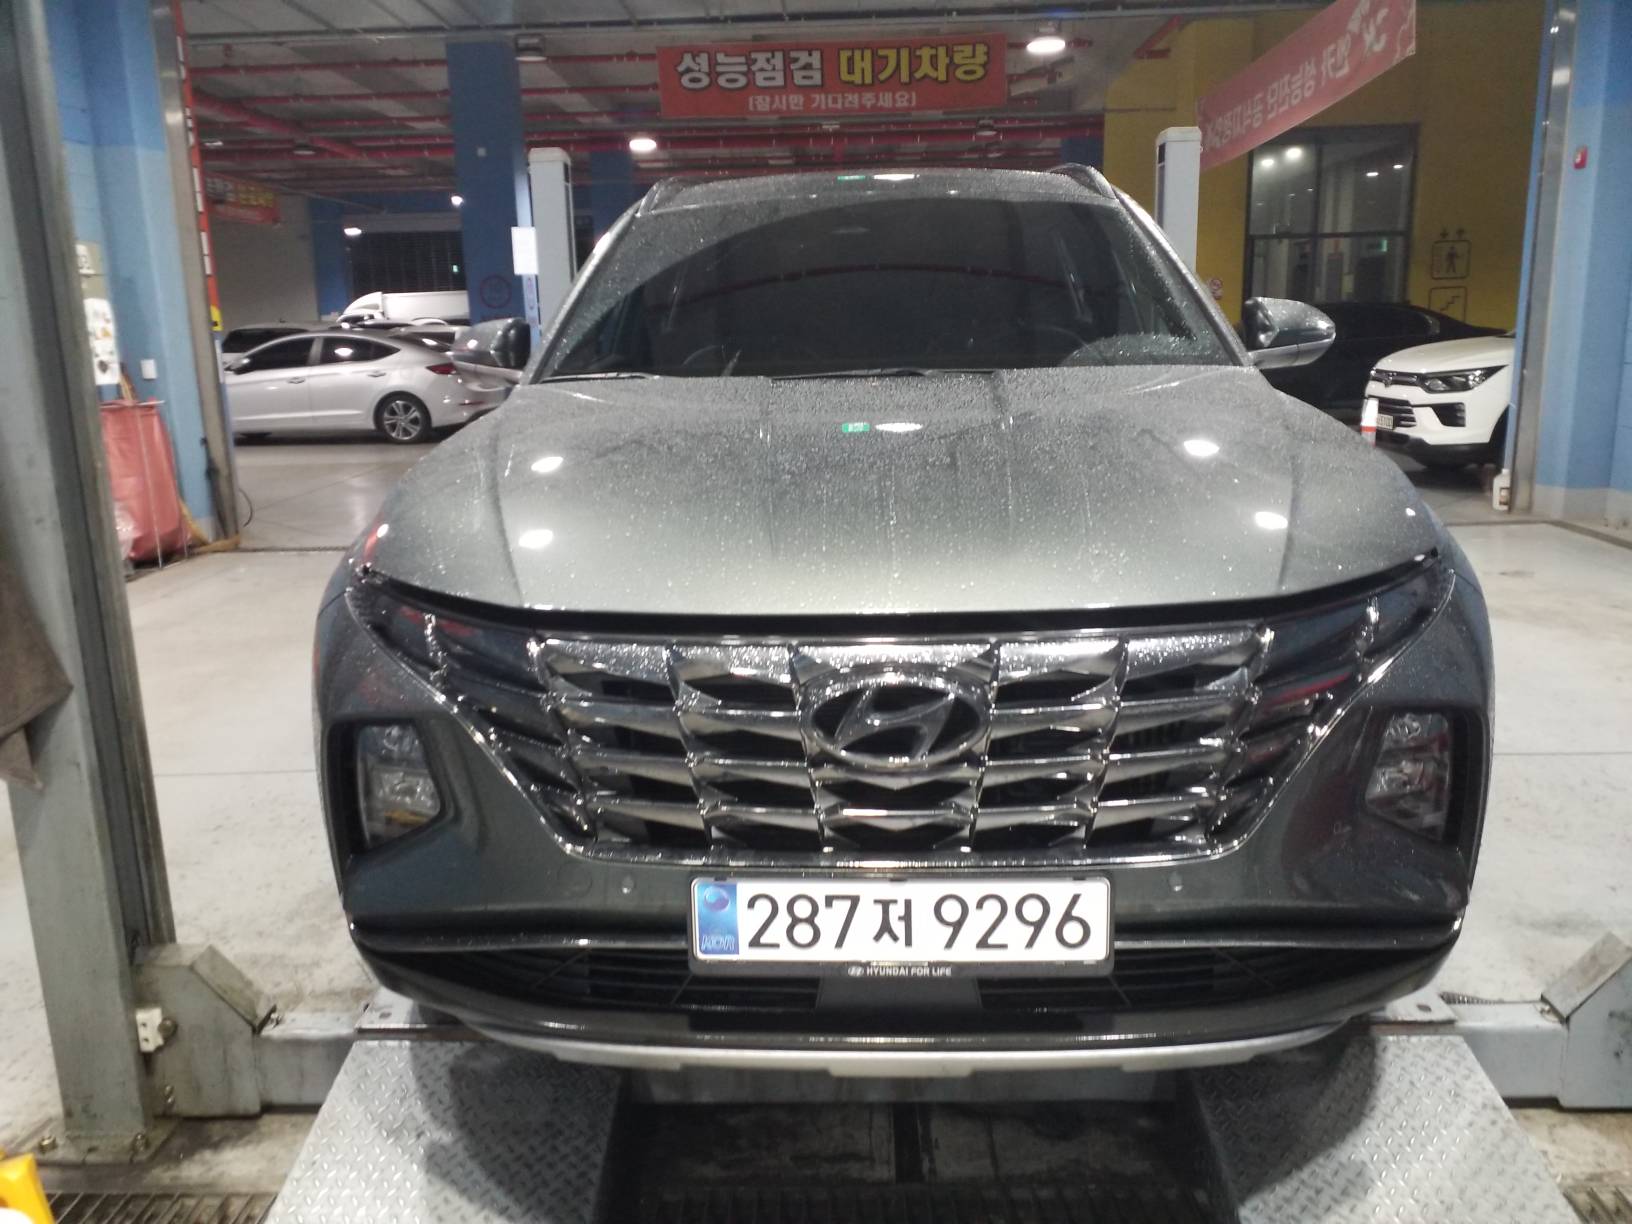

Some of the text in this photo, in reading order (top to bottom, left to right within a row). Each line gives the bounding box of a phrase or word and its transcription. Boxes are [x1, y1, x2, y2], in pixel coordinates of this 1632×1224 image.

[675, 42, 989, 90] 성능점검 대기차량
[746, 892, 1092, 950] 287저 9296
[866, 965, 952, 977] HYUNDAI FOR LIFE
